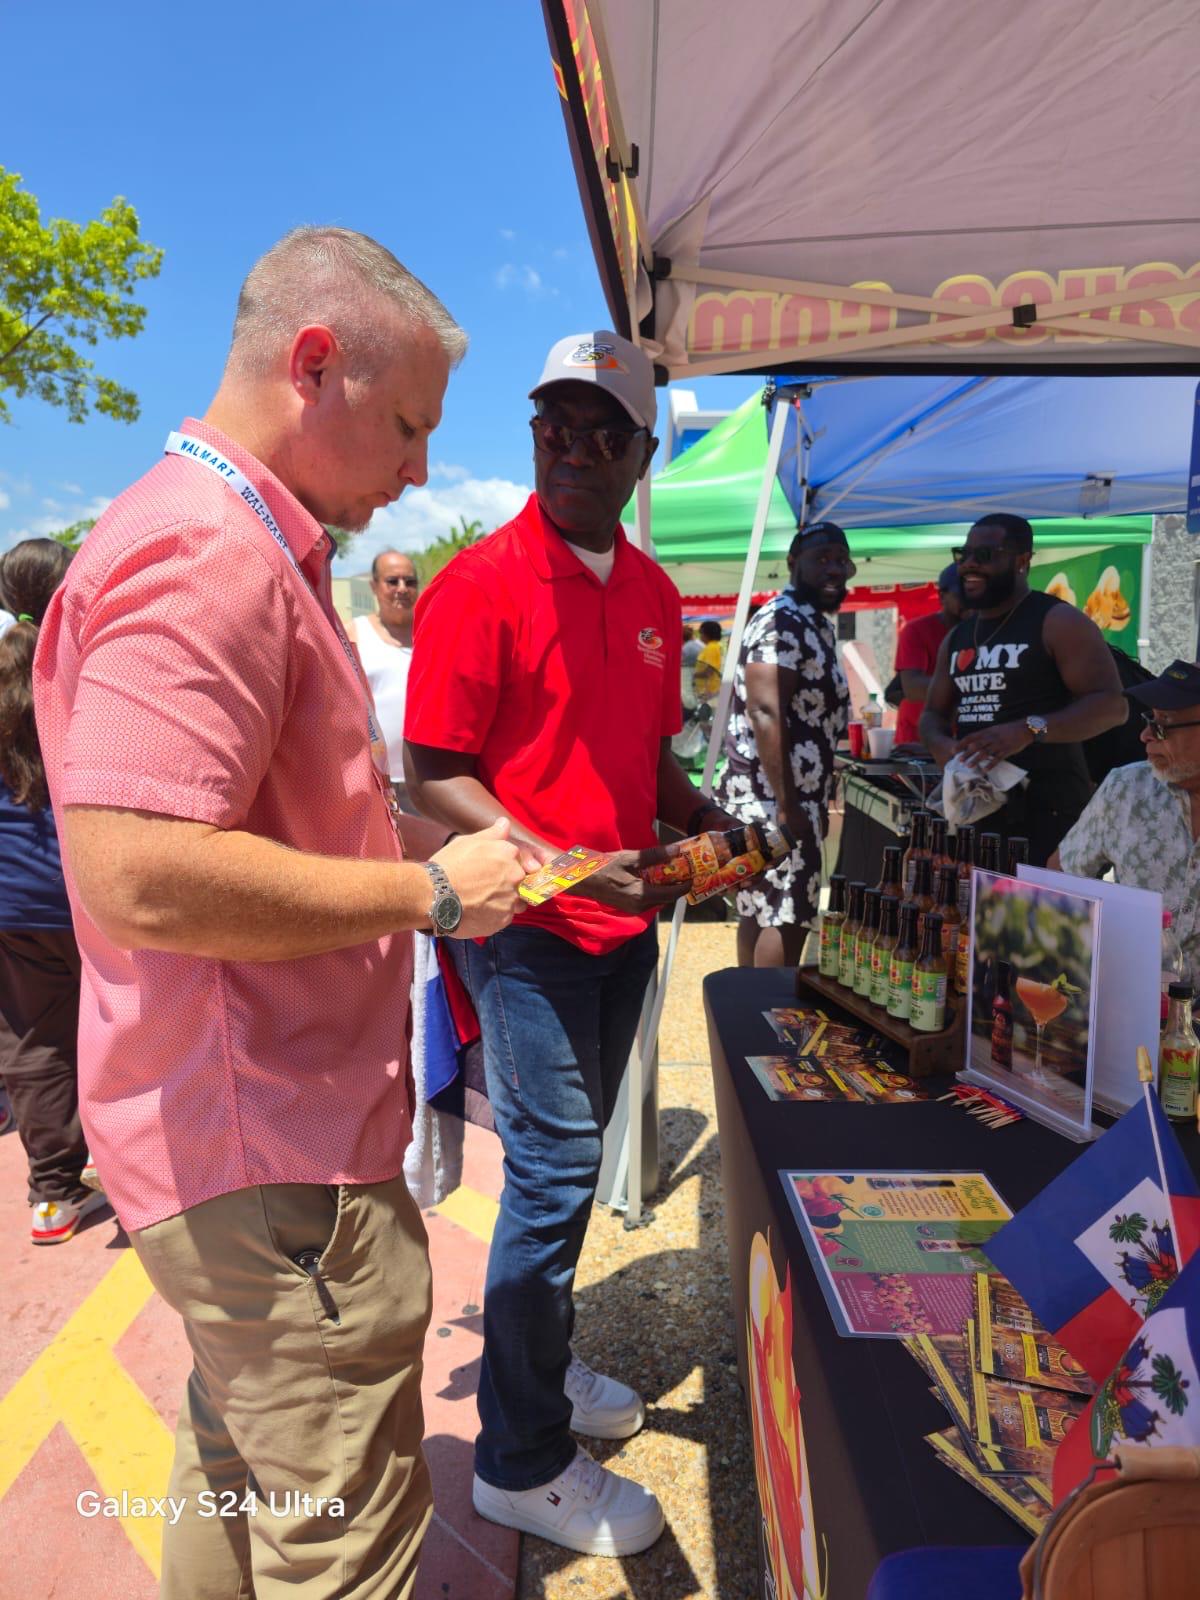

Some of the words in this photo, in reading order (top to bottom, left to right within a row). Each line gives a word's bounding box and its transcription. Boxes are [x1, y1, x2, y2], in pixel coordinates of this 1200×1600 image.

[180, 440, 236, 477] WALMART
[240, 486, 289, 550] WAL-MART
[950, 652, 958, 674] I
[975, 644, 1029, 670] MY
[954, 672, 1007, 693] WIFE
